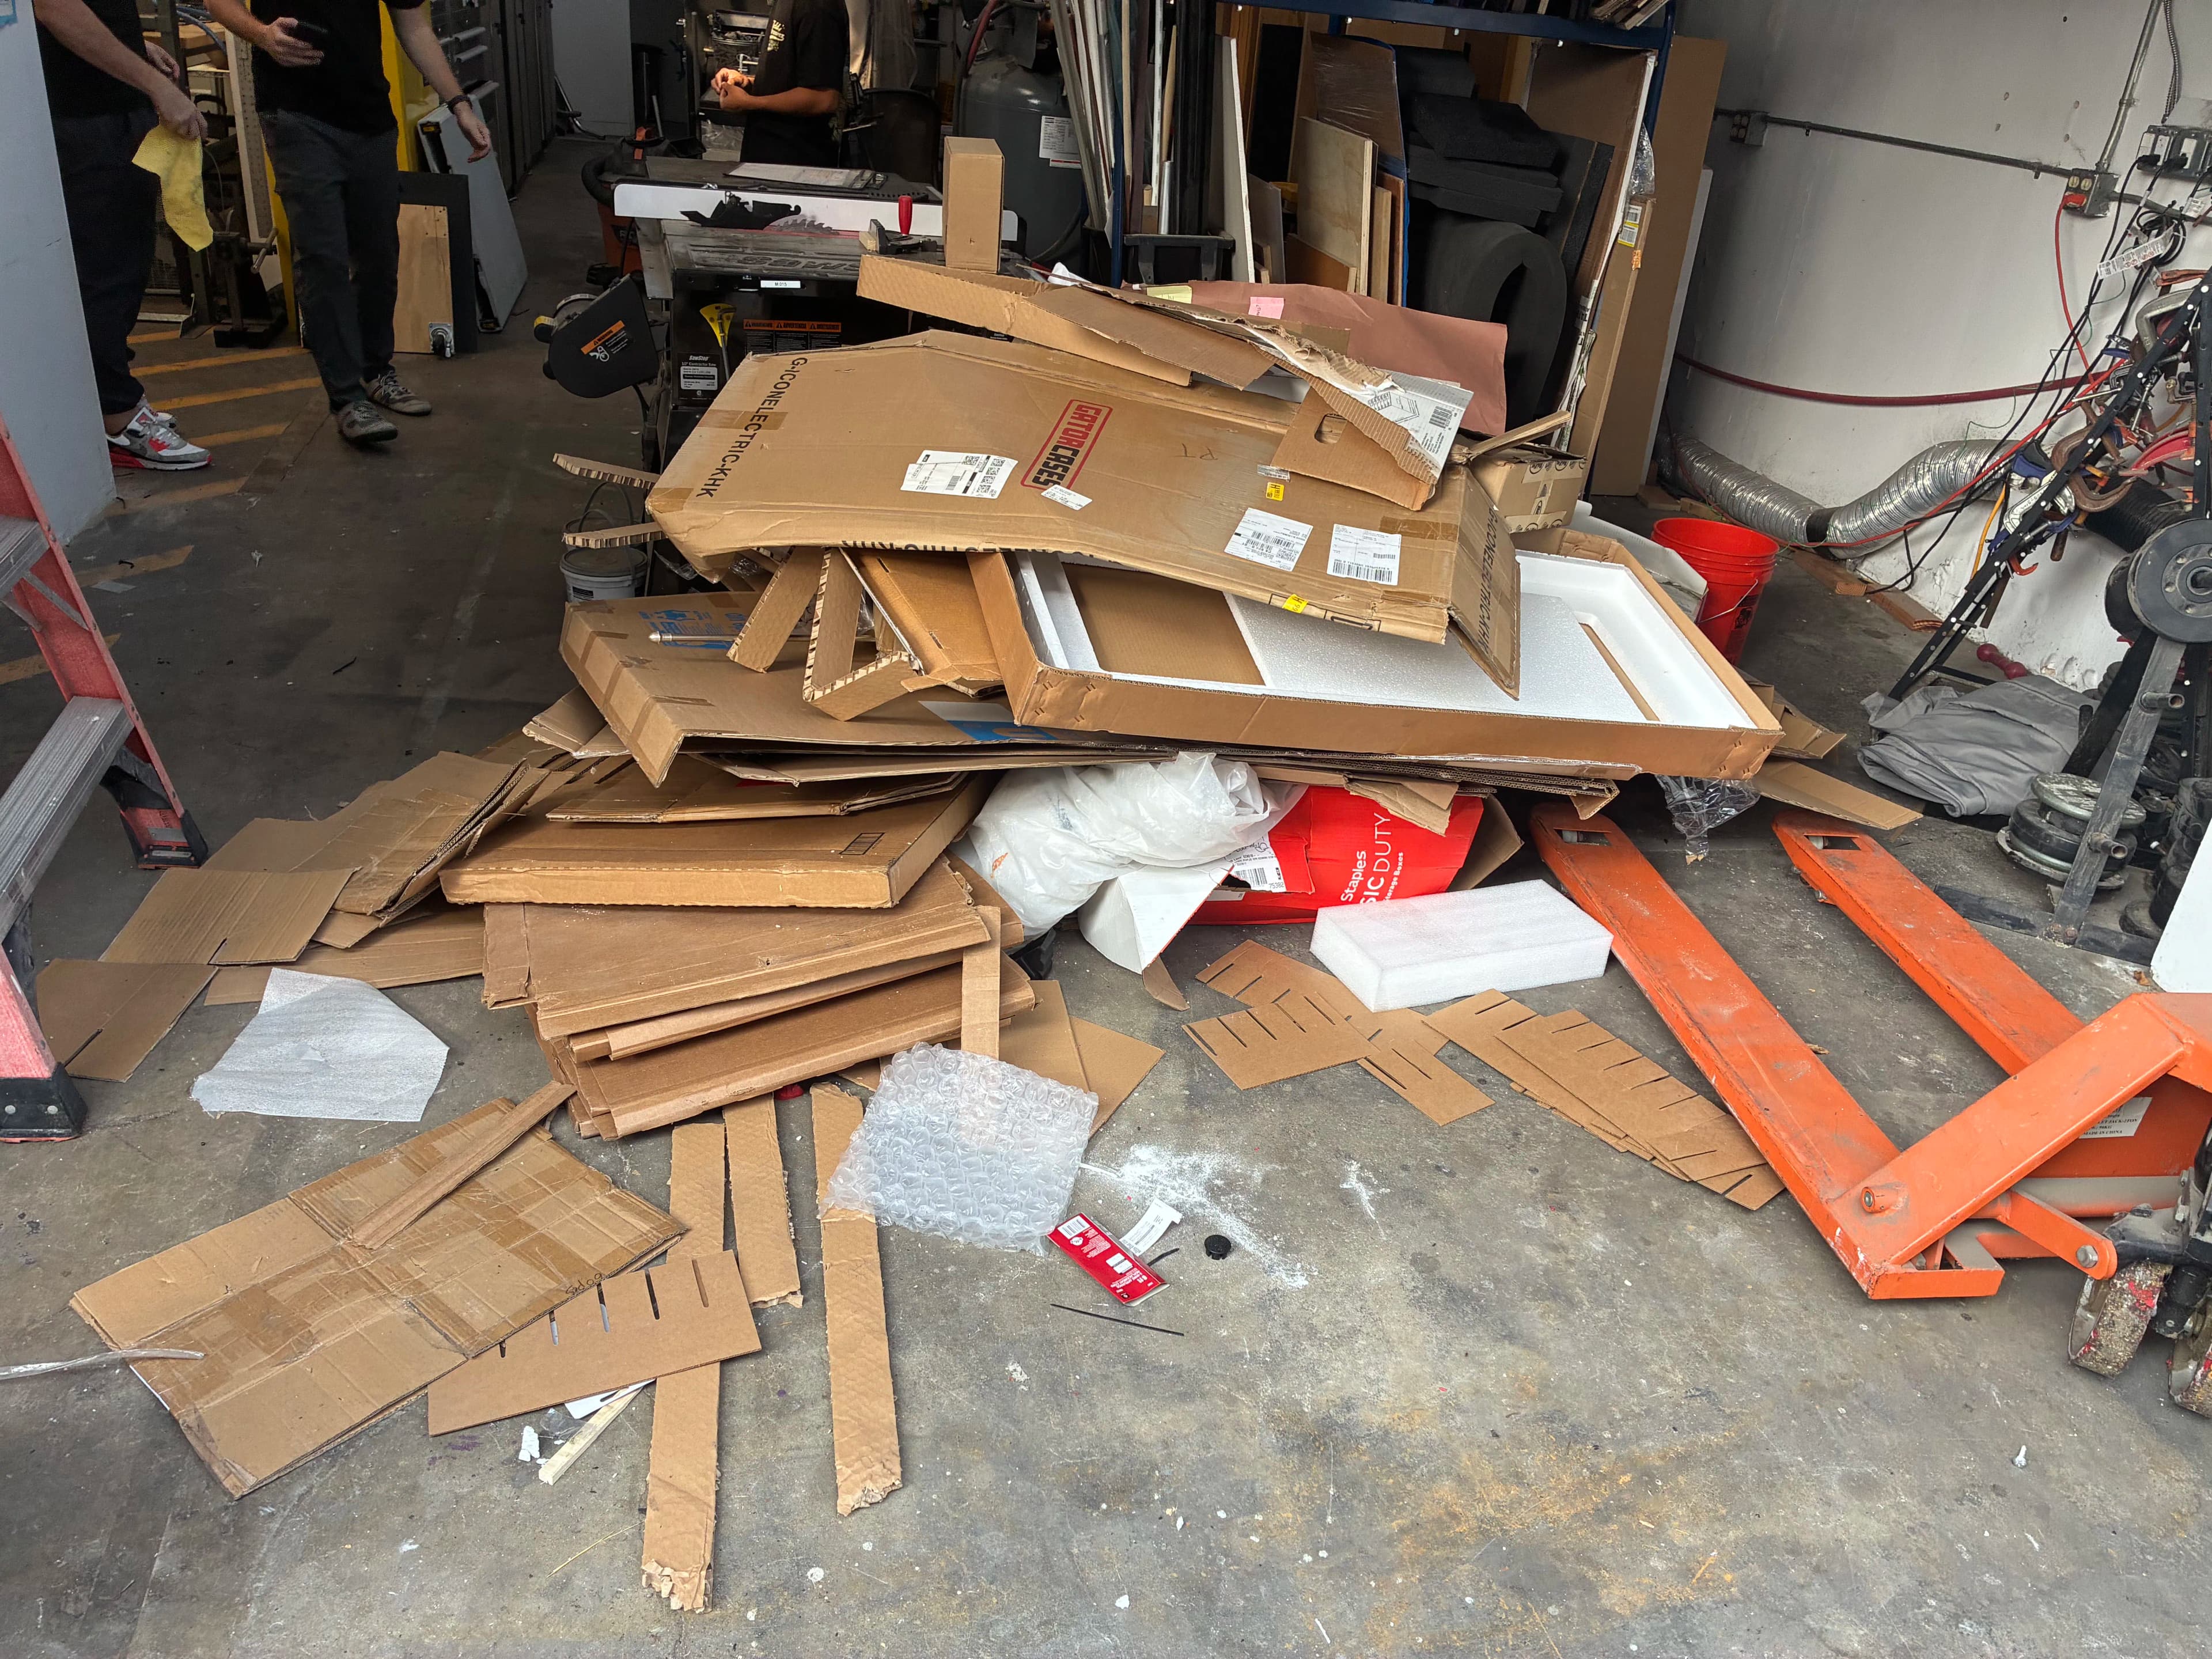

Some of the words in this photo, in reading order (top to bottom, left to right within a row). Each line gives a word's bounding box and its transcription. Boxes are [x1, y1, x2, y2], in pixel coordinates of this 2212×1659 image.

[695, 357, 808, 498] G-ICONELECTRIC-KHK
[1373, 812, 1392, 872] DUTY
[1393, 852, 1404, 876] Boxes
[1340, 850, 1366, 902] Staples
